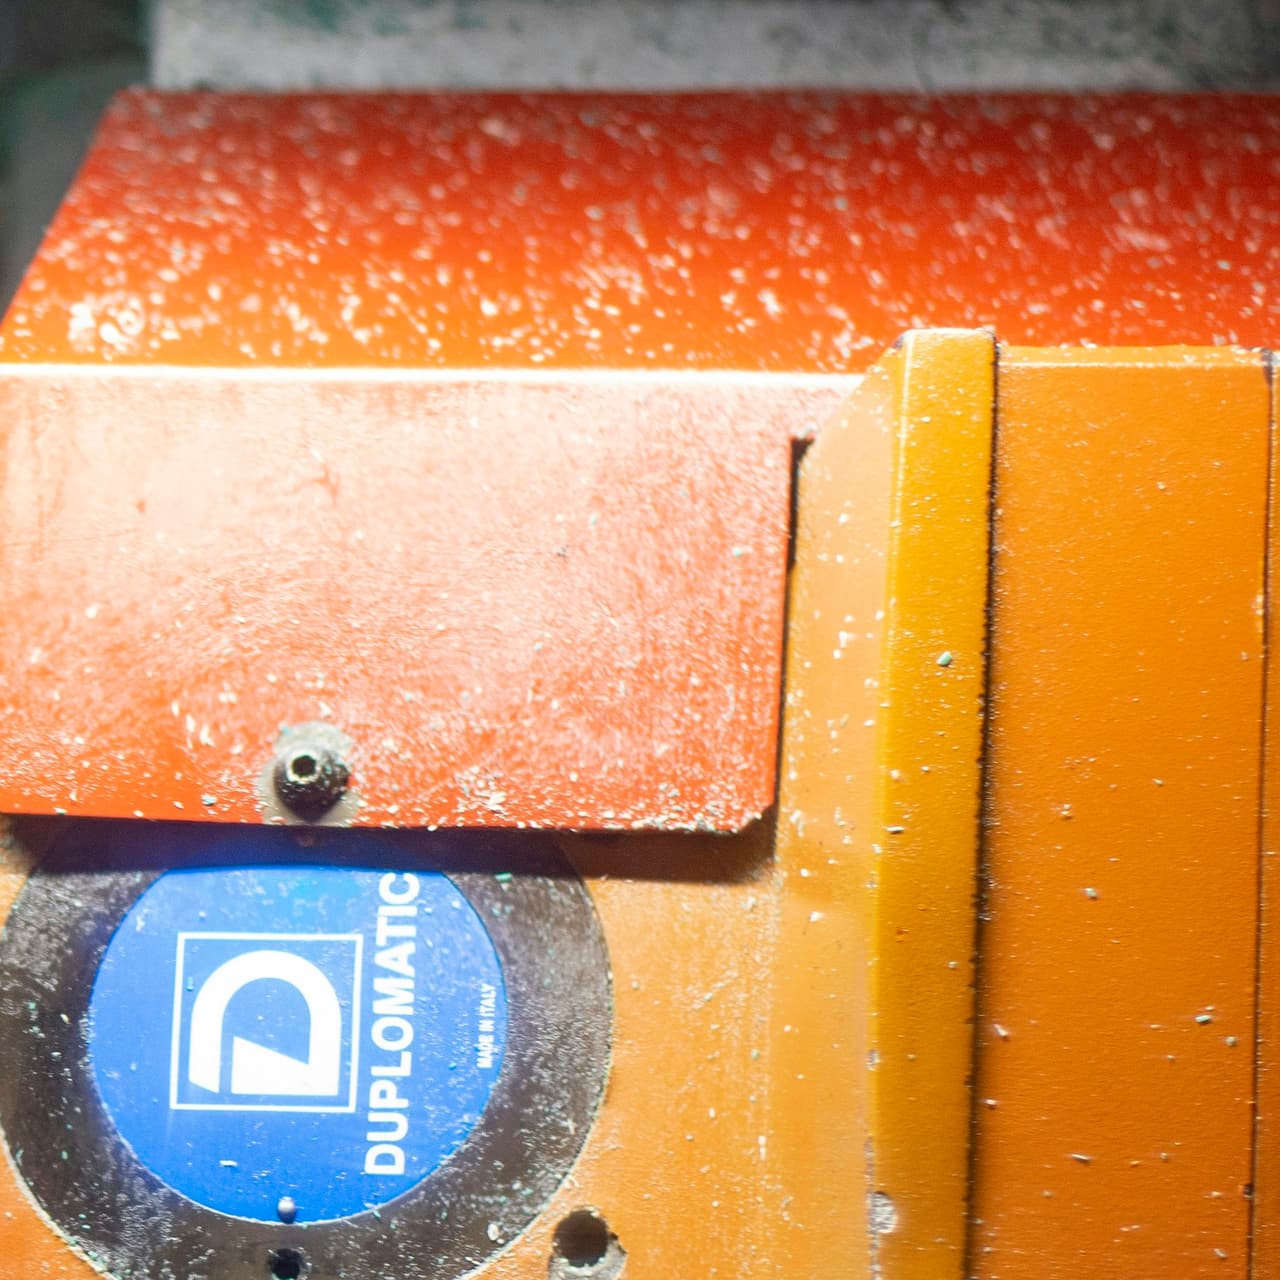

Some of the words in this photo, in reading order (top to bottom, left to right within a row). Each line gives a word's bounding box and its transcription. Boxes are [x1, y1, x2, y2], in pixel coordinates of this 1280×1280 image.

[480, 982, 497, 1018] ITALY
[365, 871, 421, 1175] DUPLOMATIC
[479, 1019, 496, 1032] IN
[476, 1034, 495, 1069] MADE
